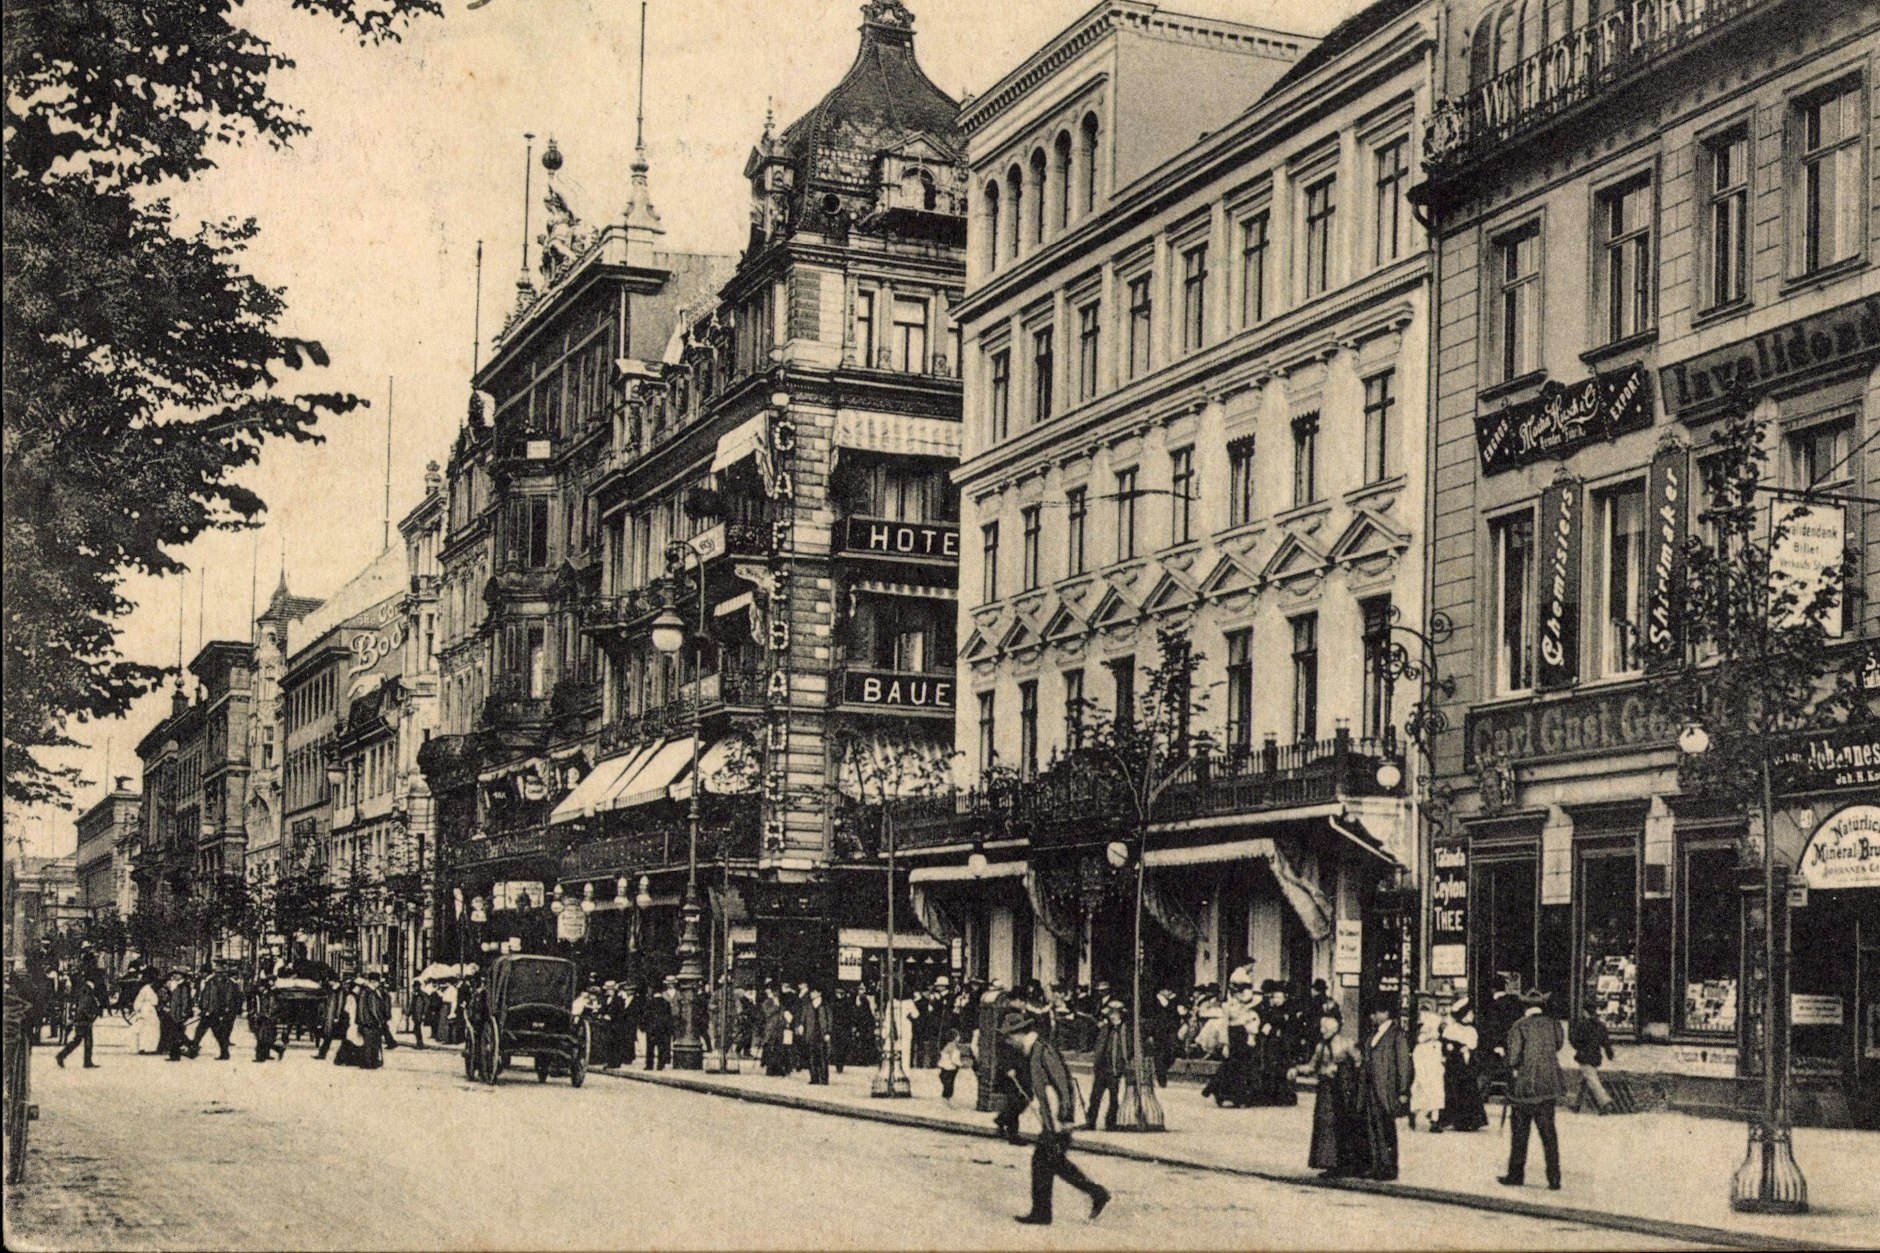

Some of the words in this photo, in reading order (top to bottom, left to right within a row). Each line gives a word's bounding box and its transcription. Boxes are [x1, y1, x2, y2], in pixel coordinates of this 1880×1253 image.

[1608, 372, 1642, 422] EXPORT
[869, 524, 959, 556] HOTE
[863, 677, 951, 707] BAUE
[1829, 814, 1880, 847] Natürlic
[1434, 906, 1464, 931] THEE
